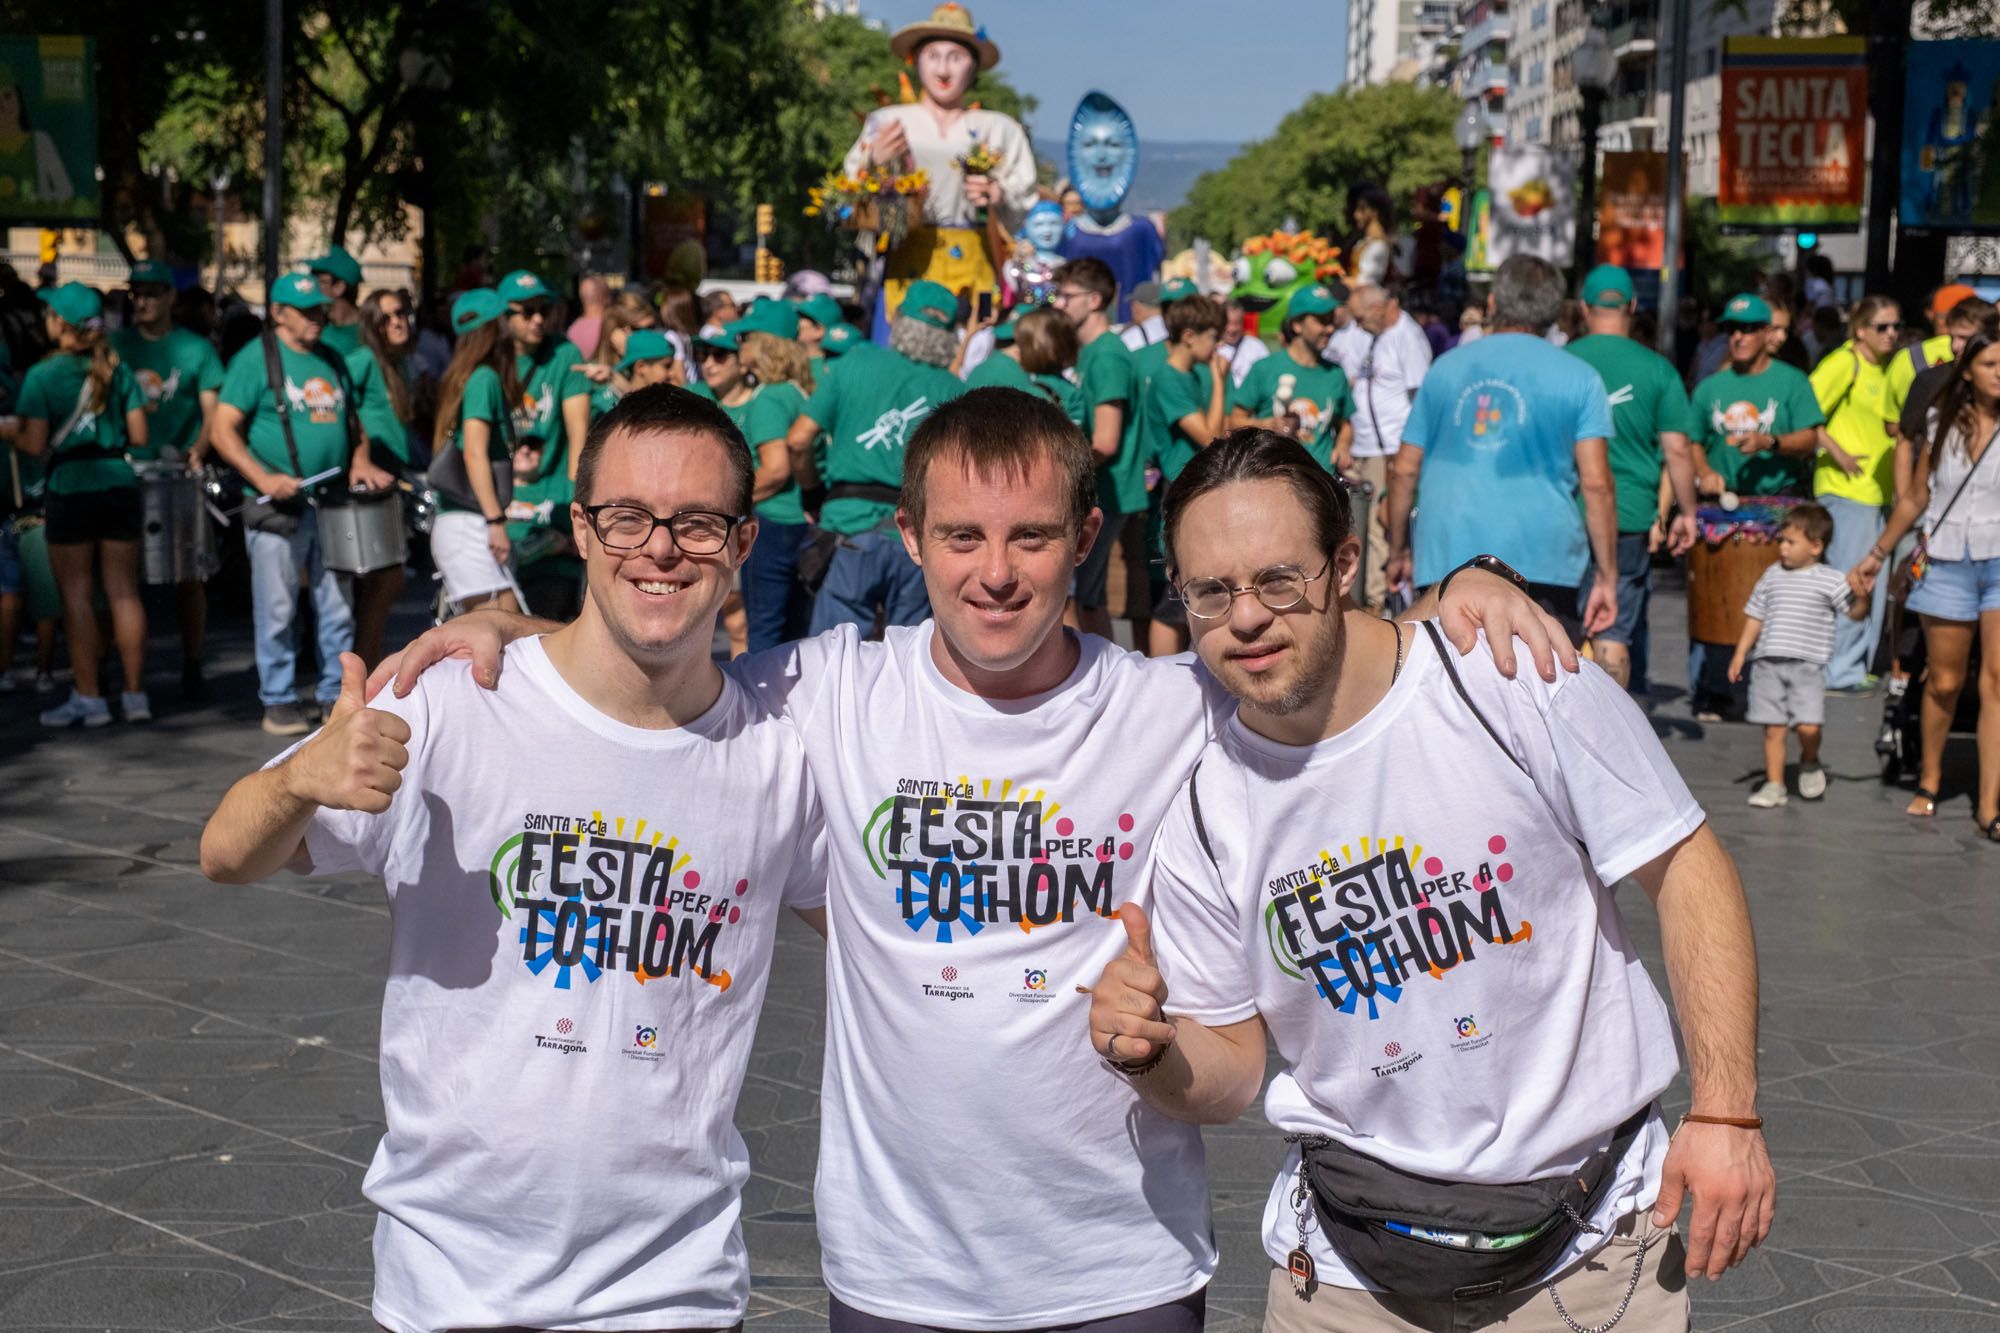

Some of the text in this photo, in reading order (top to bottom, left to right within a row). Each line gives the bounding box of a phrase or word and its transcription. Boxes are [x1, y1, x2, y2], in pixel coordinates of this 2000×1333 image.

[1736, 77, 1850, 119] SANTA
[1735, 122, 1849, 168] TECLA
[896, 778, 938, 796] SANTA
[524, 813, 570, 832] SANTA
[888, 795, 1116, 861] FESTA PER A
[516, 832, 730, 916] FESTA PER A
[887, 859, 1115, 925] TOTHOM
[1269, 869, 1308, 896] SANTA
[1273, 847, 1494, 955] FESTA PER A
[514, 897, 723, 978] TOTHOM
[1297, 886, 1514, 1010] TOTHOM
